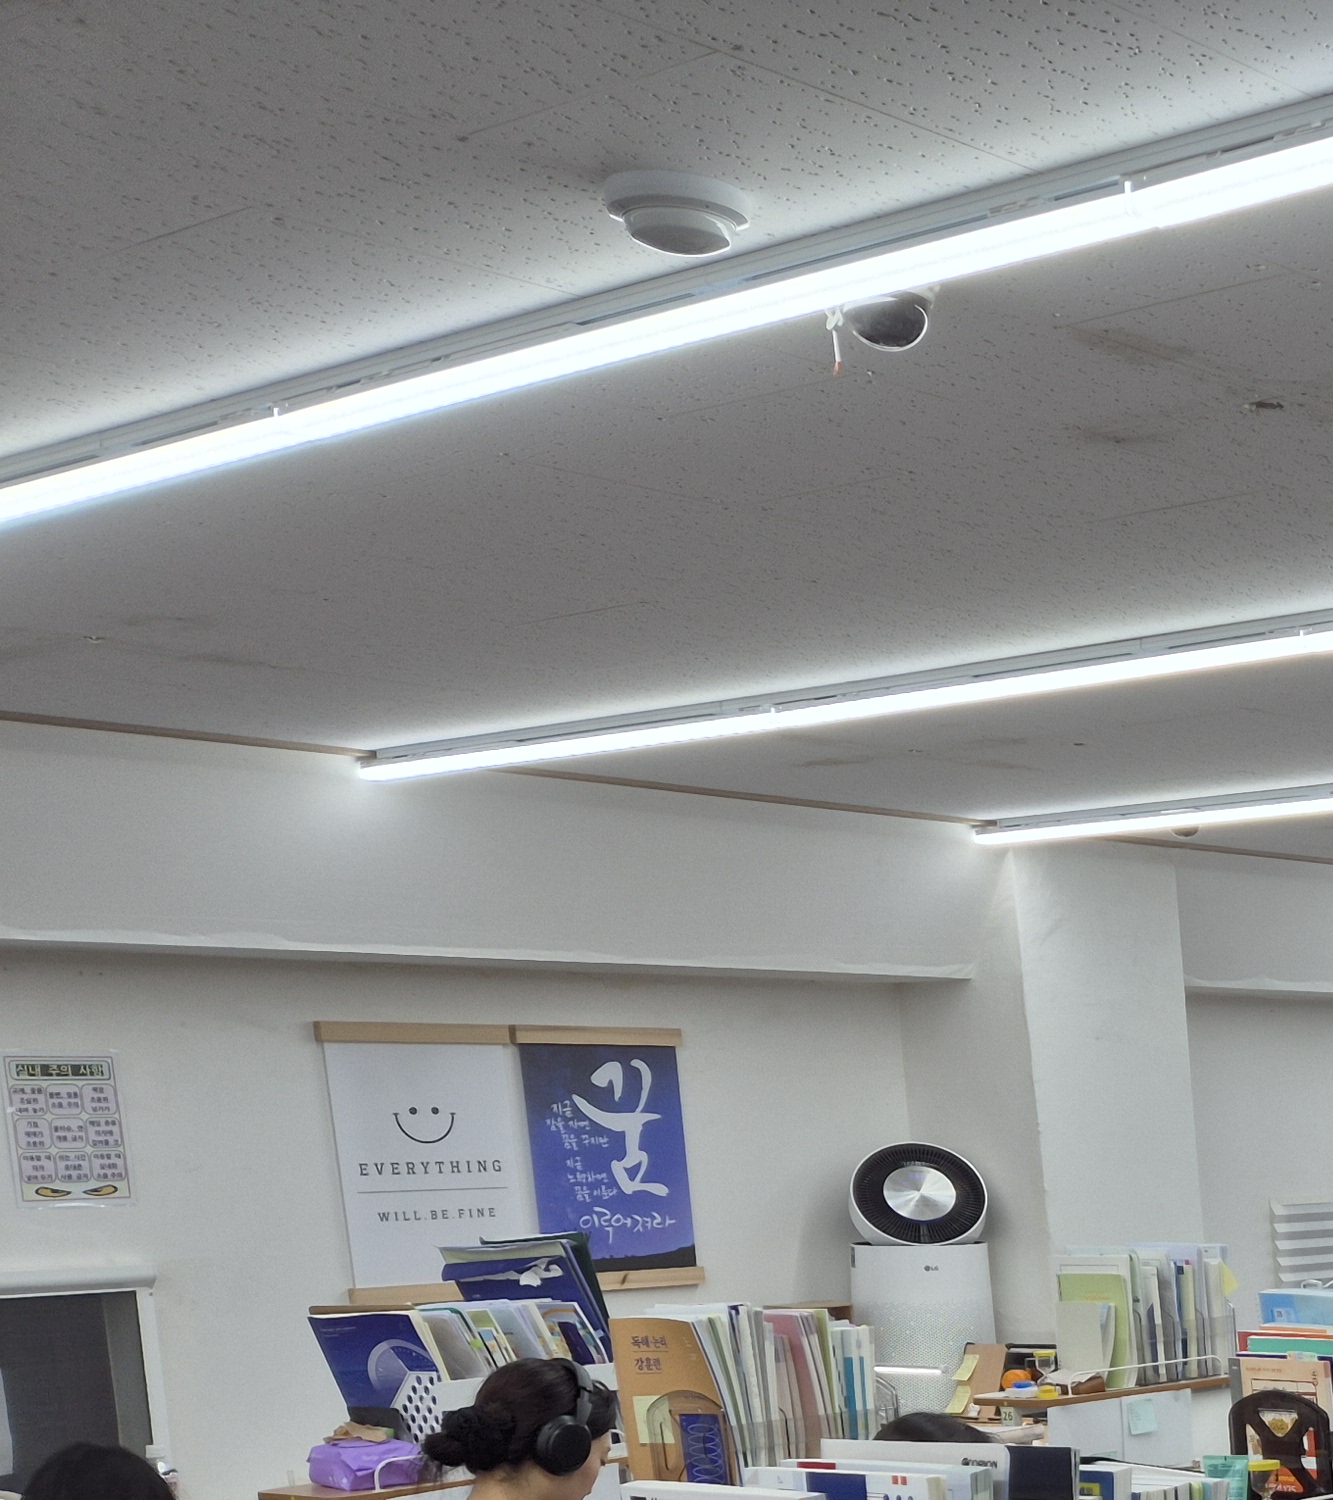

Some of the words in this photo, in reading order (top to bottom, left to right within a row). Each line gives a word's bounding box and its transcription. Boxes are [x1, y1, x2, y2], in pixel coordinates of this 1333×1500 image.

[48, 1064, 71, 1077] 주의
[359, 1158, 503, 1178] EVERYTHING
[1003, 1411, 1013, 1421] 26
